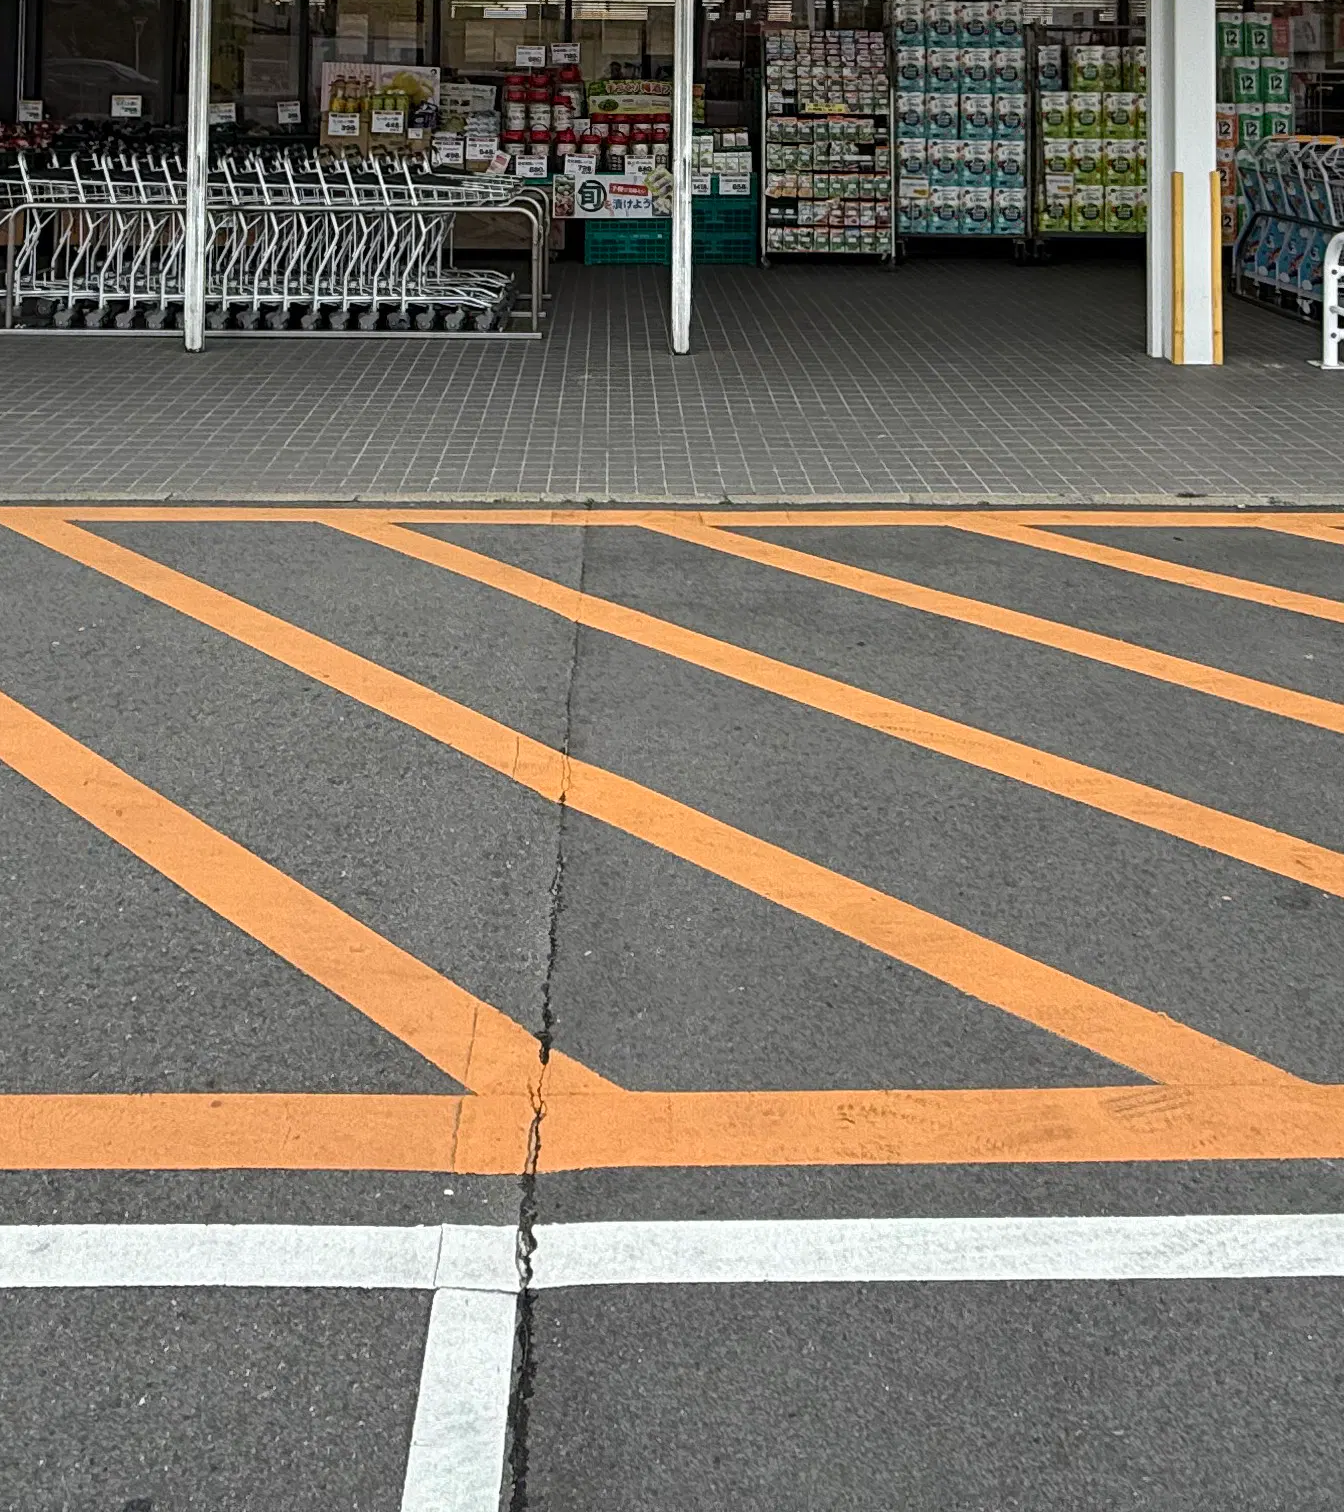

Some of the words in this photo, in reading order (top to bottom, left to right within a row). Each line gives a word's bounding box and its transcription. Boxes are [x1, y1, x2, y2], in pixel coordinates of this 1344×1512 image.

[1225, 31, 1238, 45] 12
[1254, 31, 1266, 45] 12
[1241, 75, 1254, 90] 12
[1270, 75, 1283, 90] 12
